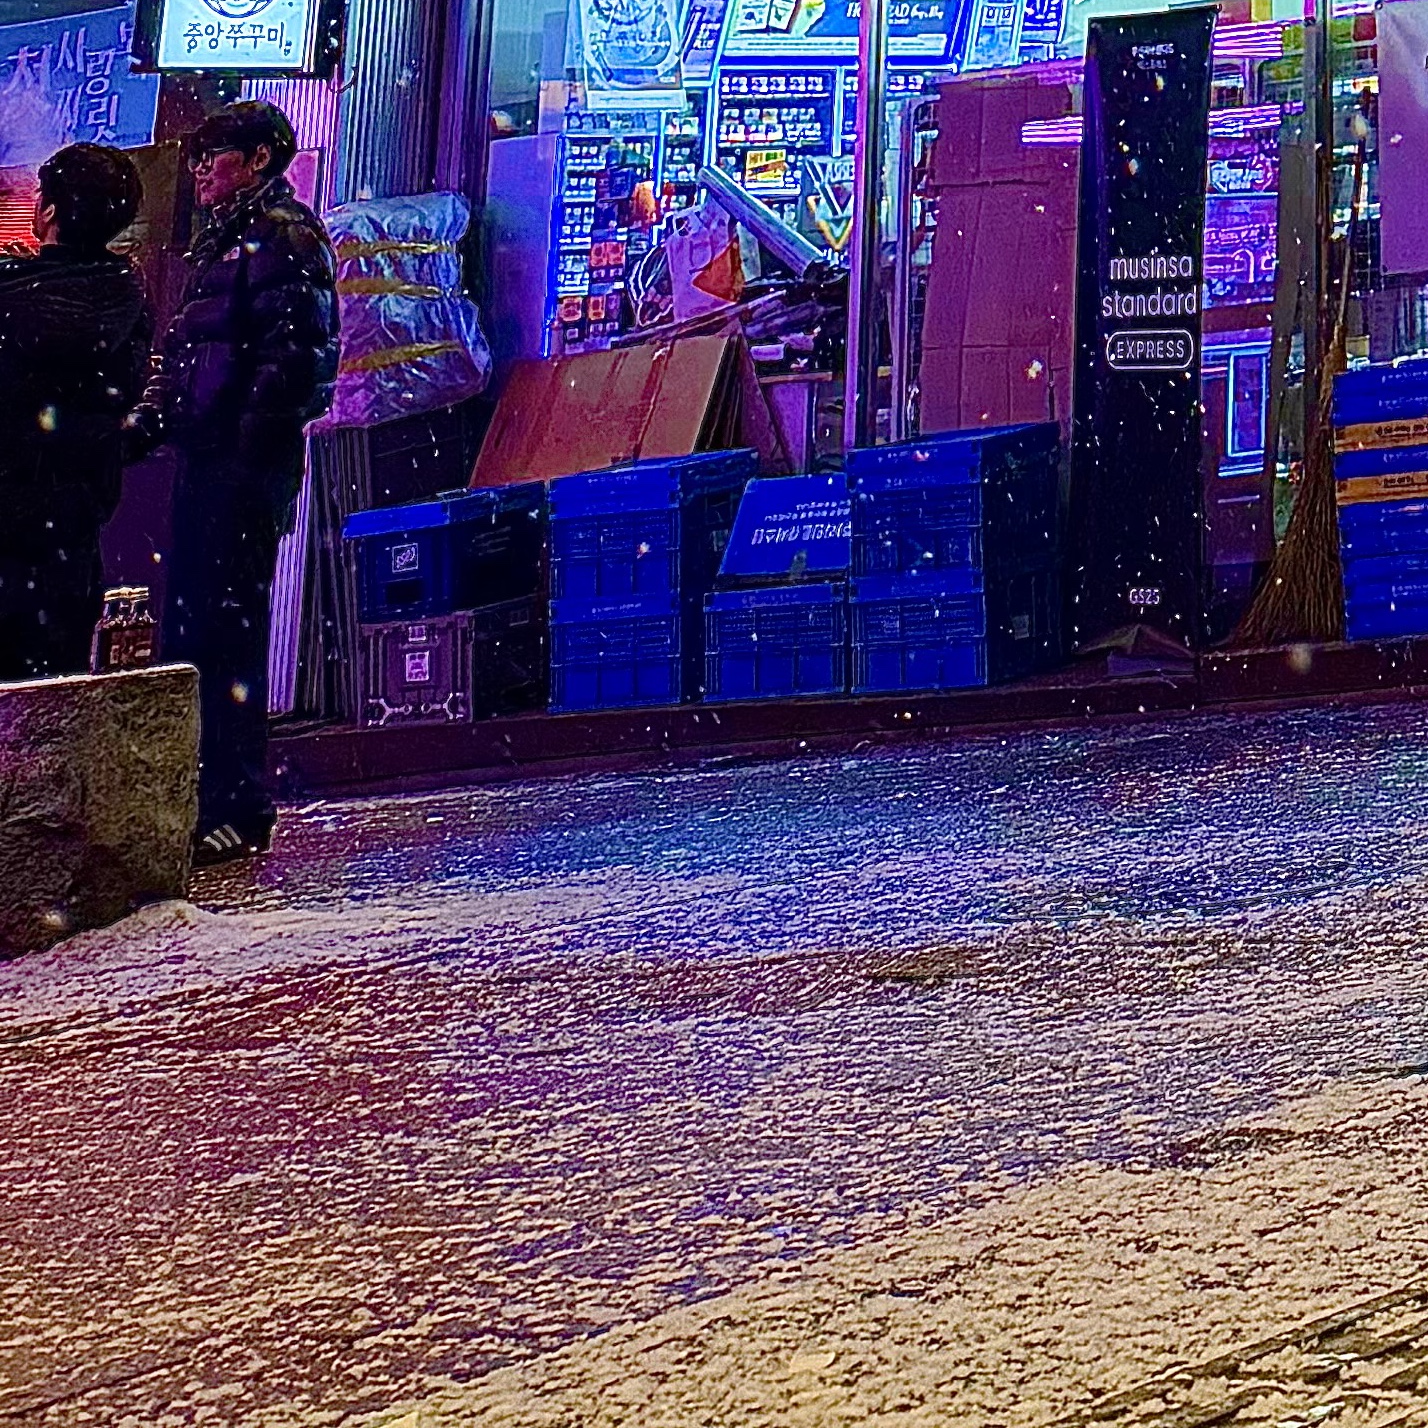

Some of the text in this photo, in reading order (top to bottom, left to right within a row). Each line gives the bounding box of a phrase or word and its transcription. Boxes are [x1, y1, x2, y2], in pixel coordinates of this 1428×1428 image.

[1109, 248, 1194, 282] musinsa
[1101, 284, 1198, 317] standard
[1115, 337, 1187, 361] EXPRESS
[1129, 587, 1162, 606] GS25
